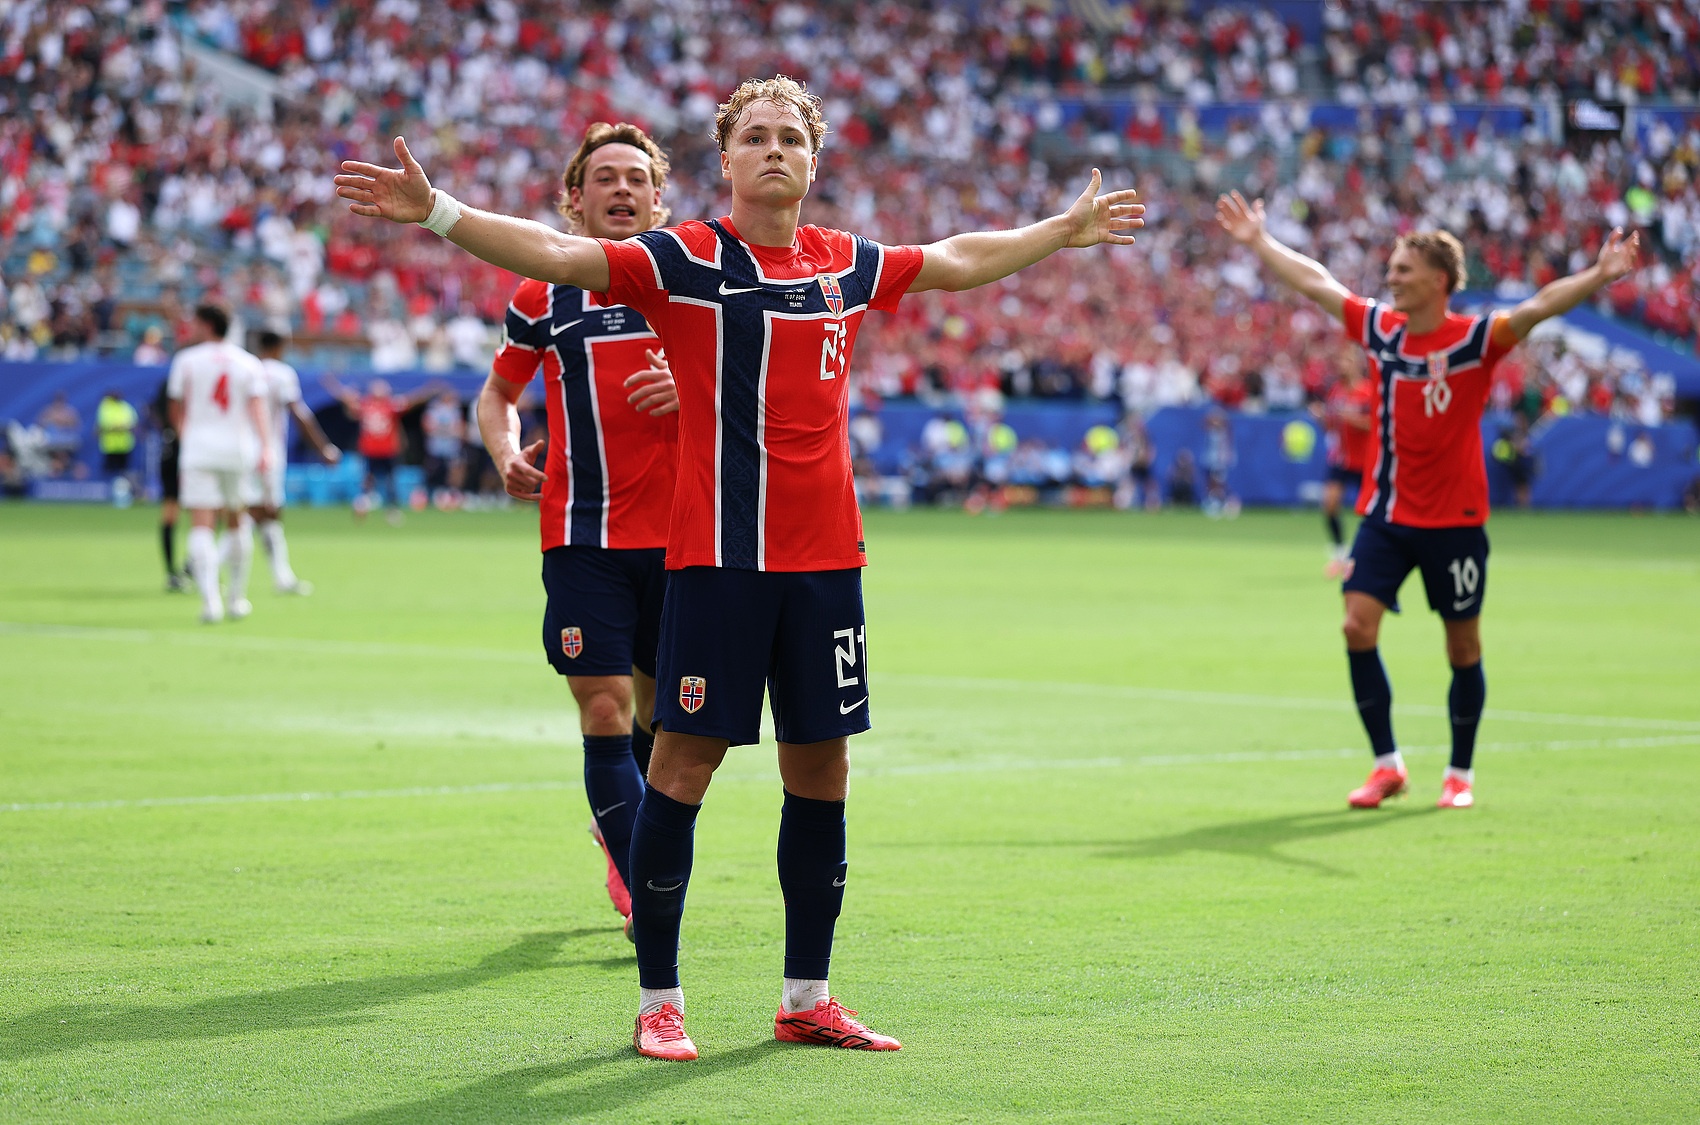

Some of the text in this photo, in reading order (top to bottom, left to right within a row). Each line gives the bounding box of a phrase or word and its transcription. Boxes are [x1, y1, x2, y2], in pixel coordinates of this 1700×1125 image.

[210, 372, 230, 412] 4
[1421, 379, 1452, 418] 10
[1448, 556, 1479, 597] 10
